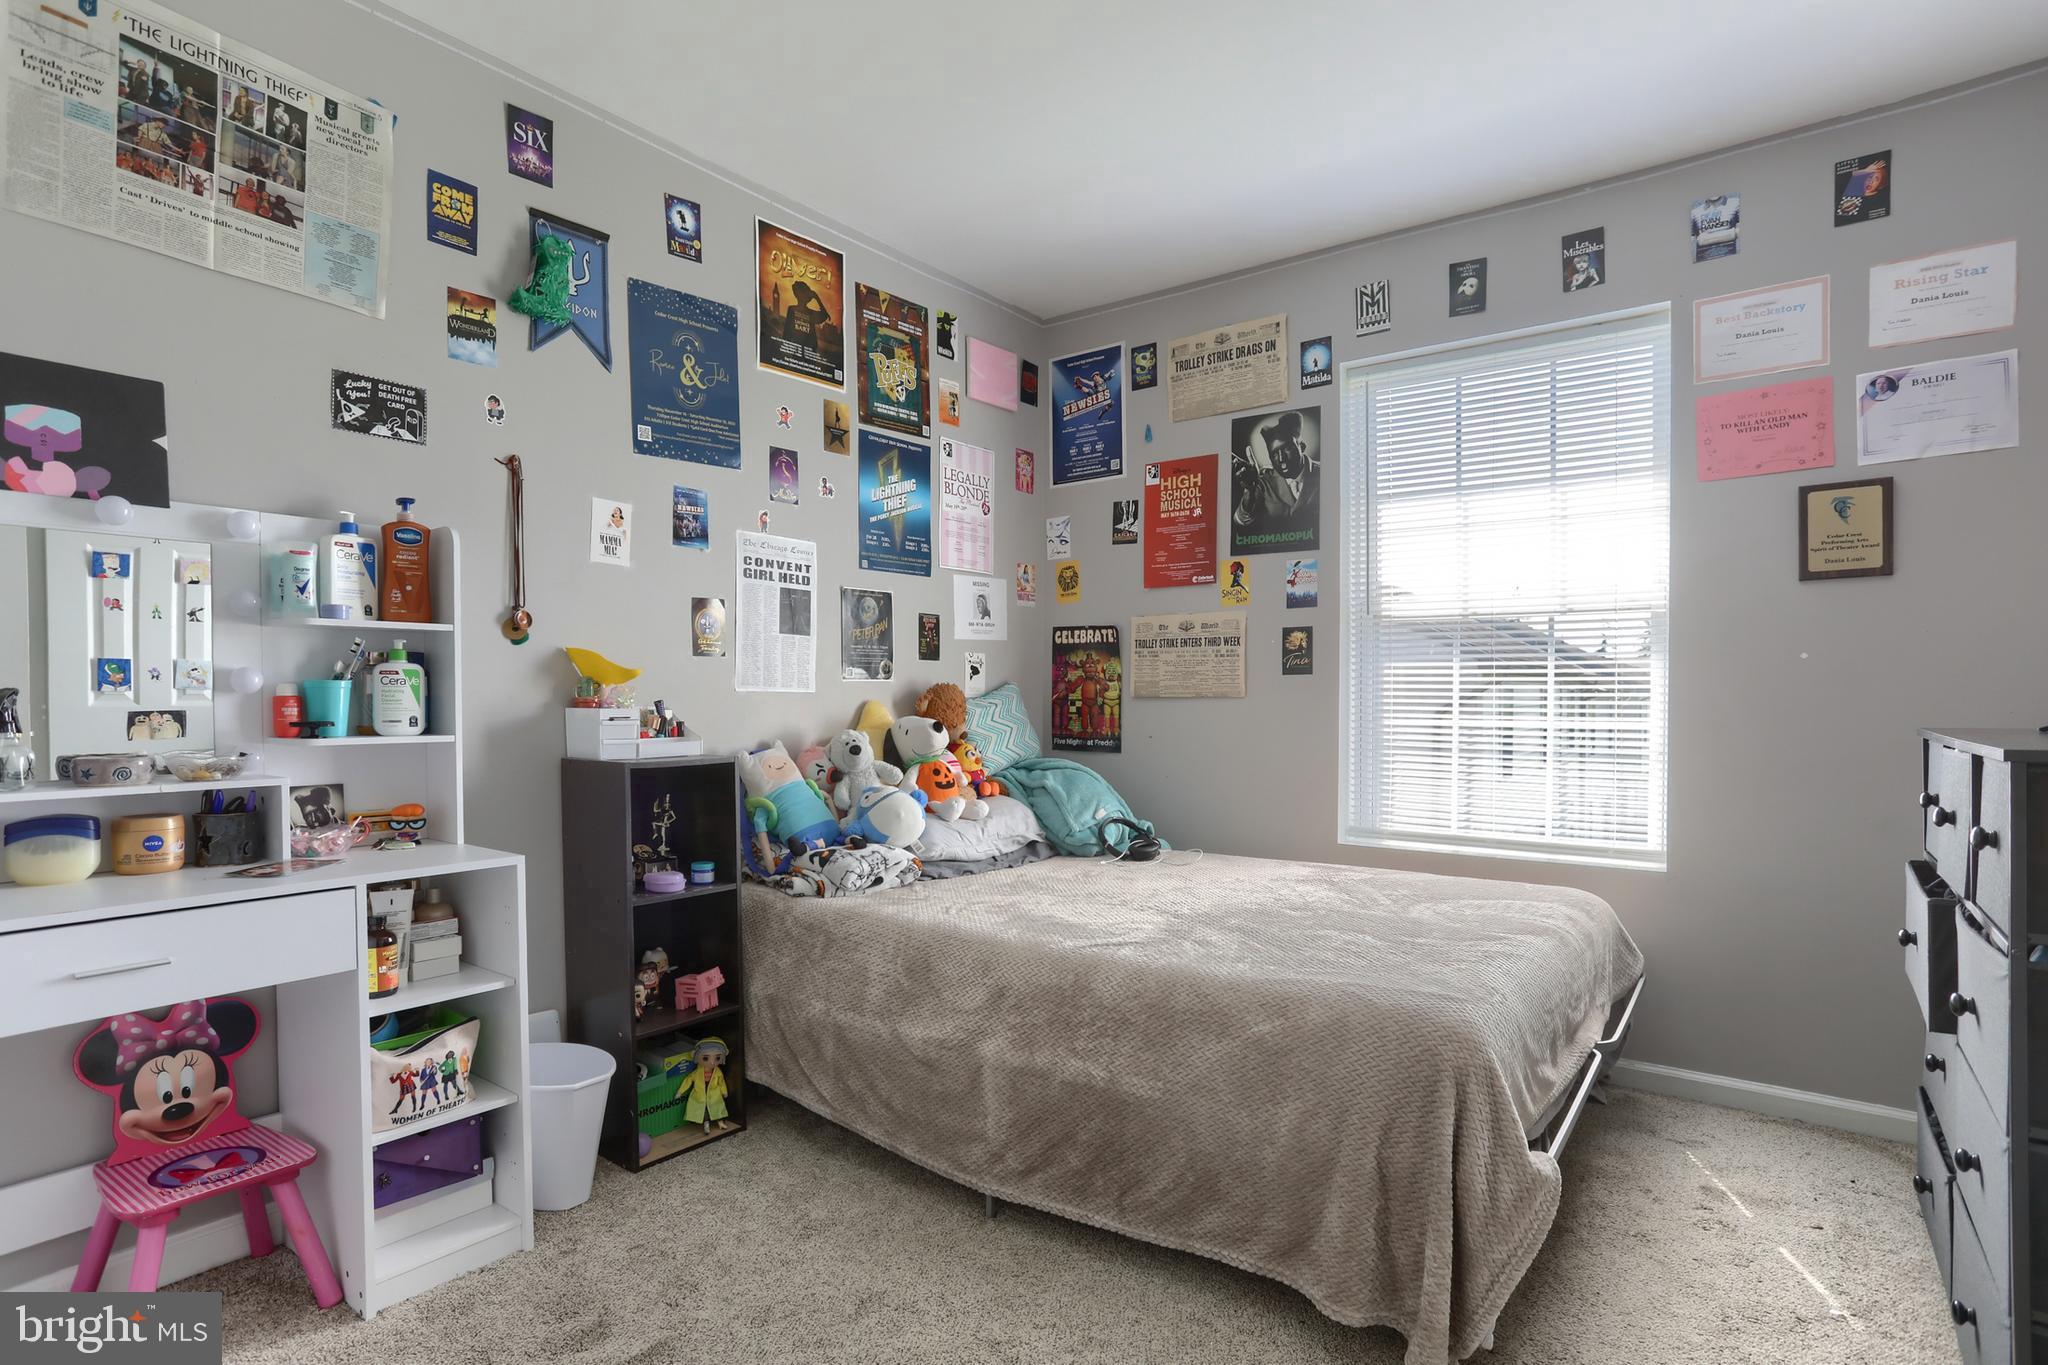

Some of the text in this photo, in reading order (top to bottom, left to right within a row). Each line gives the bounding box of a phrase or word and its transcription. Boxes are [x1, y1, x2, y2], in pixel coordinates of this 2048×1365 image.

[19, 48, 105, 88] Leads, crew
[170, 35, 257, 84] LIGHTNING
[22, 59, 102, 96] bring show
[41, 77, 84, 98] to life
[314, 115, 381, 146] Musical greets
[315, 125, 336, 138] new
[365, 142, 379, 154] pit
[326, 136, 369, 157] directors
[432, 182, 474, 206] COME
[432, 192, 474, 216] FROM
[119, 185, 143, 200] Cast
[189, 210, 200, 219] to
[201, 213, 234, 229] middle
[234, 224, 264, 240] school
[264, 234, 301, 253] showing
[432, 203, 474, 226] AWAY
[1700, 216, 1721, 226] EVAN
[1700, 221, 1731, 233] HANSEN
[1575, 240, 1589, 250] Les
[1893, 273, 1949, 291] Rising
[1953, 265, 1990, 280] Star
[1910, 289, 1970, 305] Dania Louis
[1714, 314, 1741, 325] Best
[1743, 303, 1807, 321] Backstory
[449, 318, 496, 338] WONDERLAND
[1735, 326, 1785, 340] Dania Louis
[1174, 338, 1277, 373] TROLLEY STRIKE DRAGS ON
[343, 379, 372, 390] Lucky
[1301, 372, 1332, 387] Matilda
[1911, 372, 1958, 387] BALDIE
[346, 390, 371, 400] You!
[378, 383, 416, 397] GET OUT OF
[378, 391, 417, 405] DEATH FREE
[387, 401, 406, 410] CARD
[1062, 389, 1111, 417] NEWSIES
[1733, 420, 1752, 428] KILL
[1767, 415, 1787, 423] OLD
[1787, 412, 1808, 420] MAN
[1736, 421, 1791, 434] WITH CANDY
[887, 474, 899, 484] THE
[943, 466, 991, 490] LEGALLY
[1160, 473, 1202, 491] HIGH
[871, 478, 917, 502] LIGHTNING
[943, 480, 990, 503] BLONDE
[1160, 486, 1203, 502] SCHOOL
[677, 504, 705, 514] NEWSIES
[882, 493, 908, 513] THIEF
[1160, 497, 1203, 512] MUSICAL
[877, 513, 890, 521] PERCY
[890, 507, 907, 517] JACKSON
[395, 531, 422, 540] Vaseline
[599, 534, 623, 547] MAMMA
[1235, 527, 1314, 546] CHROMAKOPIA
[336, 548, 374, 563] CeraVe
[603, 545, 618, 556] MIA!
[743, 555, 812, 574] CONVENT
[742, 567, 811, 586] GIRL HELD
[852, 617, 889, 641] PETER PAN
[1054, 628, 1117, 645] CELEBRATE!
[1135, 636, 1241, 649] TROLLEY STRIKE ENTERS THIRD WEEK
[1283, 652, 1311, 669] Tina
[380, 675, 420, 686] CeraVe
[391, 1107, 437, 1125] WOMEN OF
[158, 1180, 200, 1197] Bow
